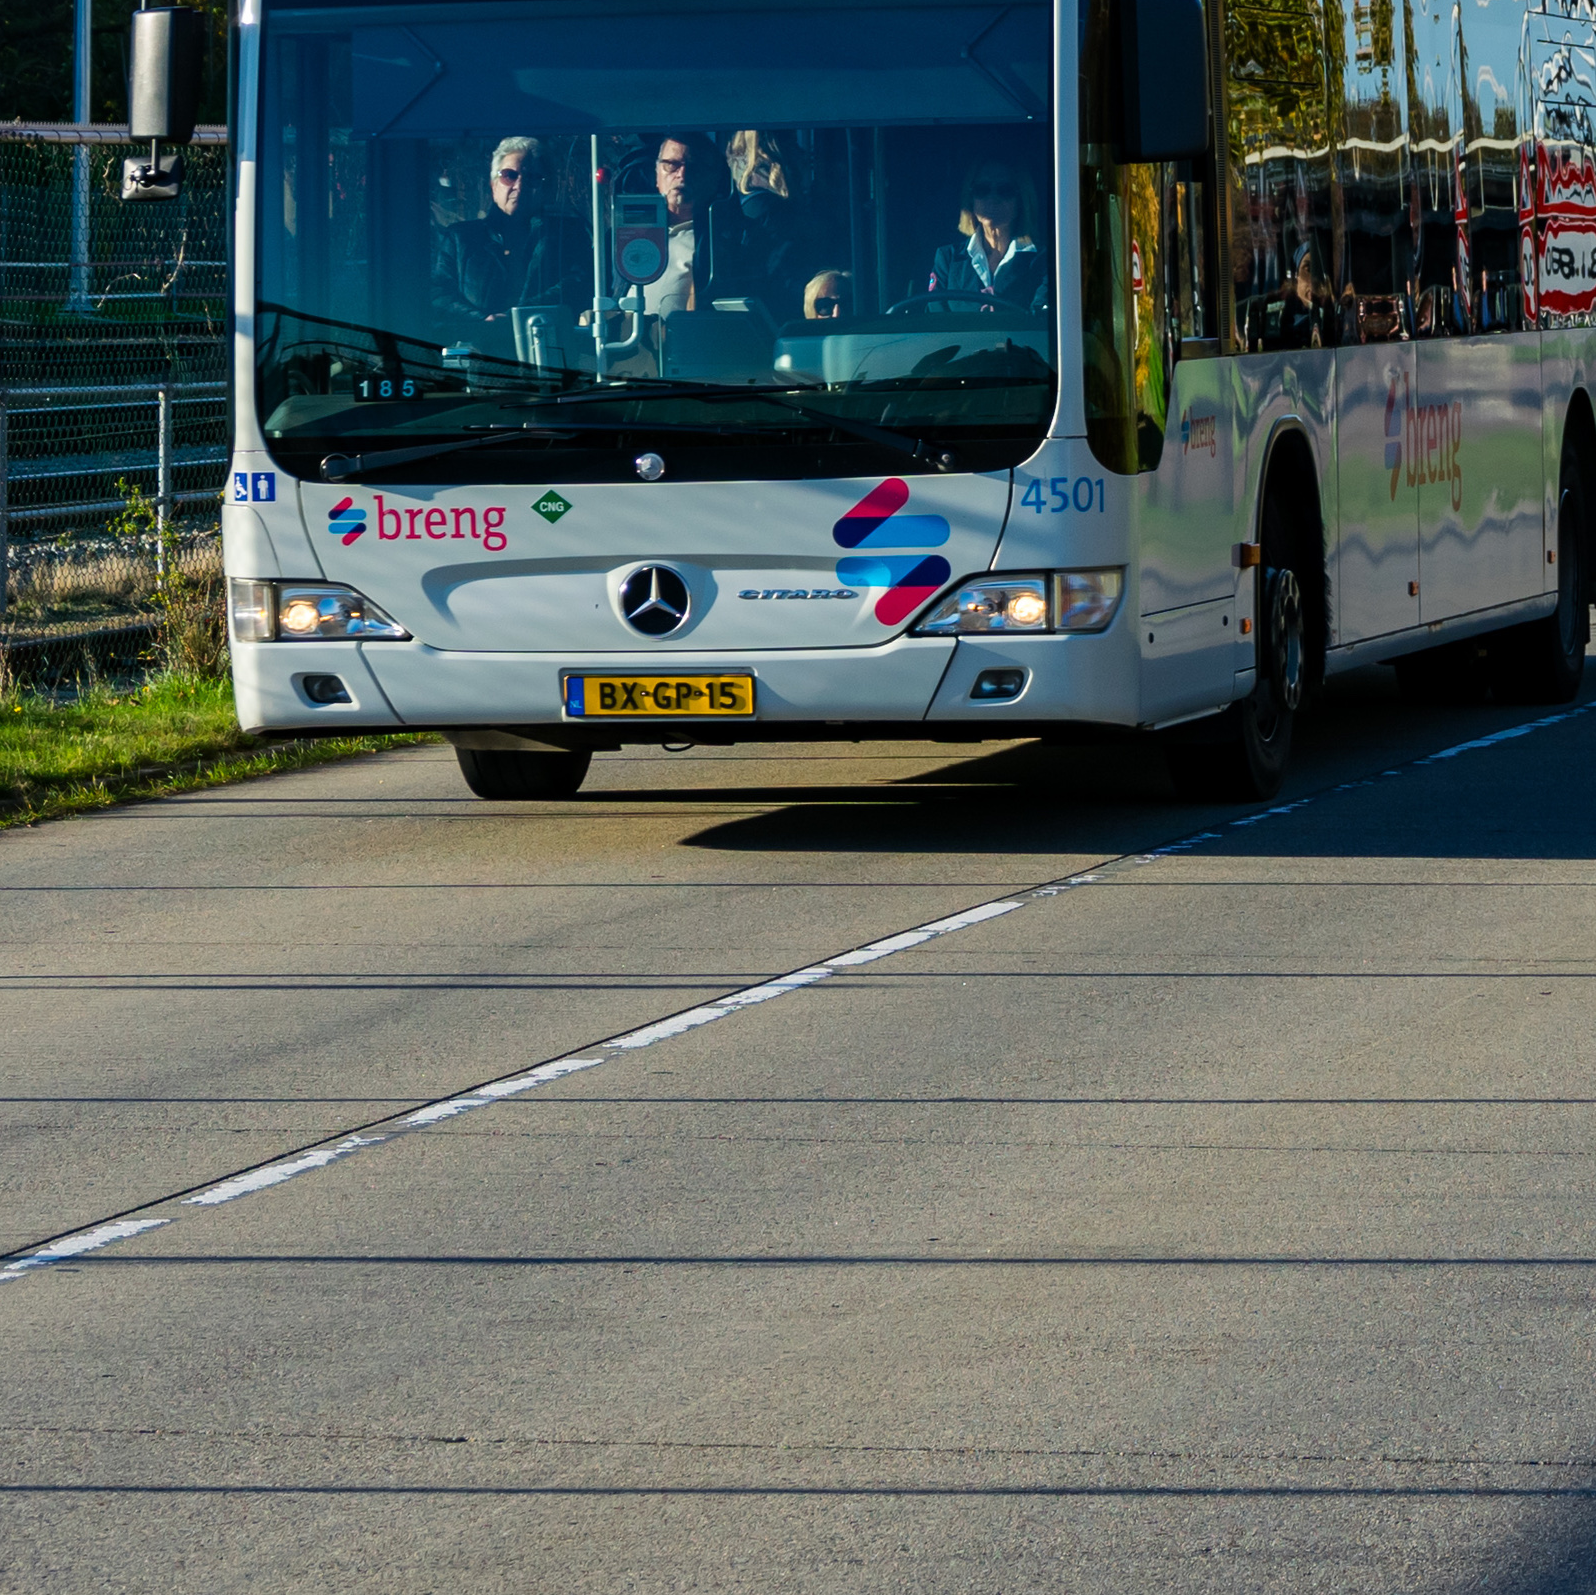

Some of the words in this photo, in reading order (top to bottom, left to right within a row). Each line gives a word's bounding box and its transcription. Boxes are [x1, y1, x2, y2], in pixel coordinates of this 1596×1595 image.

[1405, 371, 1462, 512] breng
[539, 501, 564, 513] CNG
[1020, 476, 1106, 514] 4501
[373, 494, 508, 552] breng
[737, 588, 859, 601] CITARO
[598, 681, 737, 710] BX-GP-15
